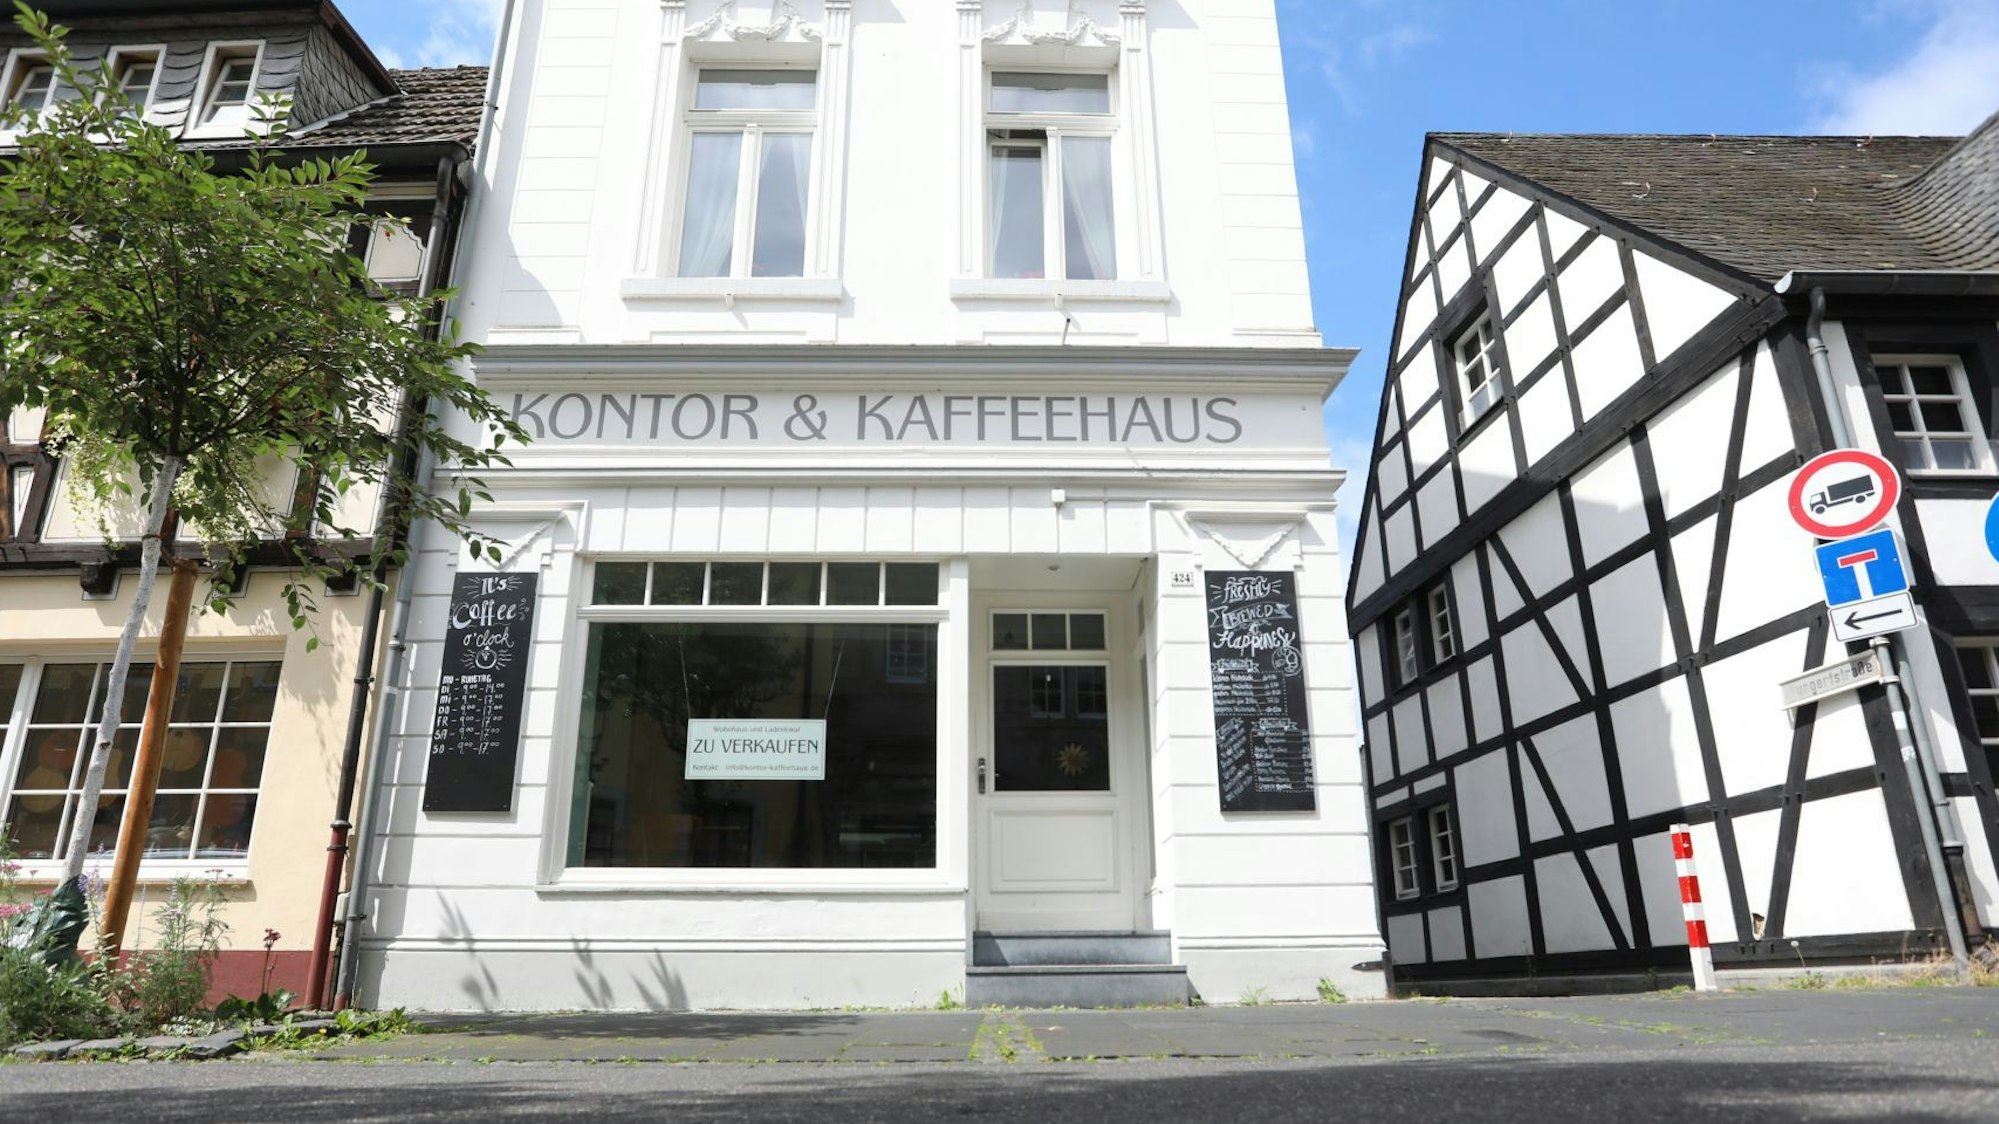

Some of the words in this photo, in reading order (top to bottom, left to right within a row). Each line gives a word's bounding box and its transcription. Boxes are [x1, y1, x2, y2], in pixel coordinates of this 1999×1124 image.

[511, 392, 758, 440] KONTOR
[784, 394, 828, 441] &
[857, 394, 1243, 444] KAFFEEHAUS
[481, 577, 508, 596] It's
[1173, 573, 1190, 583] 424
[452, 599, 517, 630] Coffee
[463, 626, 515, 648] o'clock
[693, 739, 715, 754] ZU
[721, 739, 818, 754] VERKAUFEN
